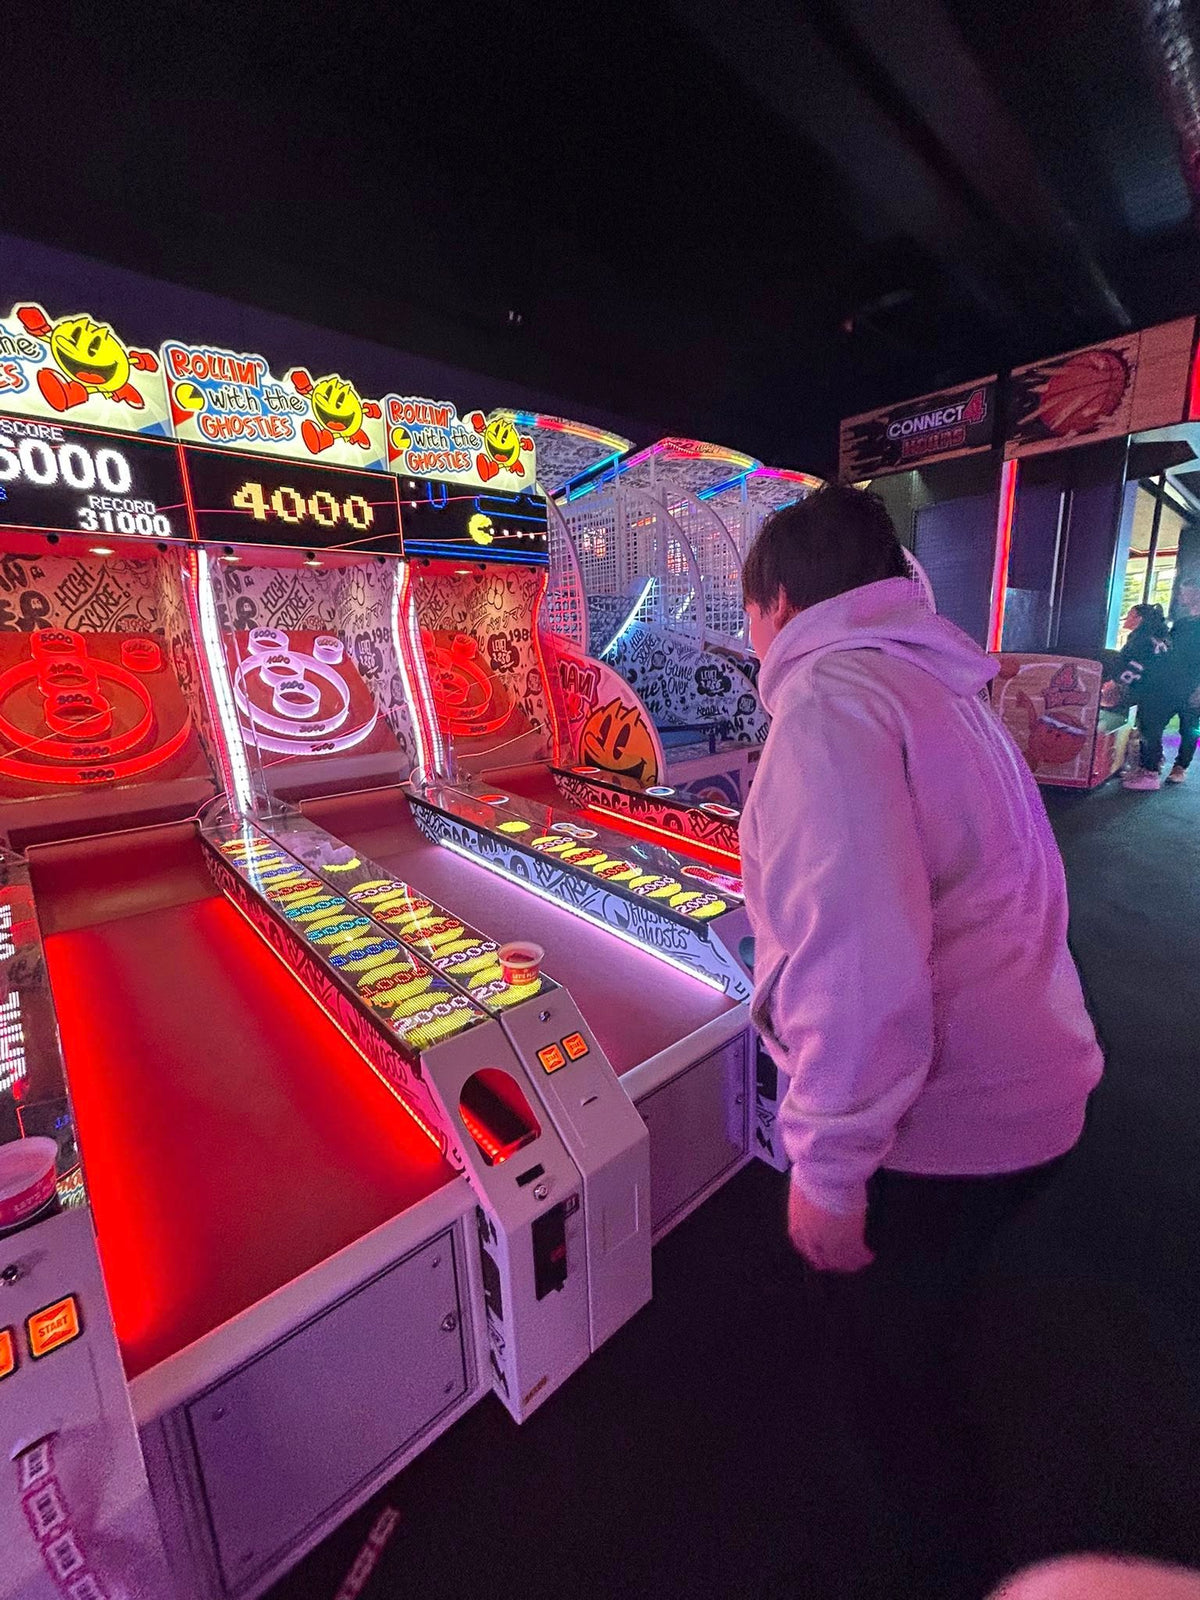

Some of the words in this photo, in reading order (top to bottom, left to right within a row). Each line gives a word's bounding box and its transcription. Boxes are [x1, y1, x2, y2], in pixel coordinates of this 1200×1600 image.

[170, 348, 264, 387] ROLLIN'
[207, 386, 261, 411] with
[264, 389, 303, 414] the
[389, 399, 453, 427] ROLLIN'
[889, 405, 965, 437] CONNECT
[0, 419, 64, 441] SCORE
[202, 415, 293, 439] GHOSTIES
[414, 430, 449, 449] with
[452, 430, 480, 450] the
[407, 450, 471, 473] GHOSTIES
[90, 495, 156, 514] RECORD
[232, 481, 374, 530] 4000
[78, 507, 171, 536] 31000
[266, 880, 322, 899] 1000
[349, 881, 405, 900] 2000
[634, 876, 675, 895] 2000
[374, 899, 430, 921] 1000
[675, 892, 718, 914] 2000
[402, 918, 460, 943] 1000
[433, 941, 497, 969] 2000
[361, 966, 429, 998] 1000
[38, 1315, 68, 1338] START
